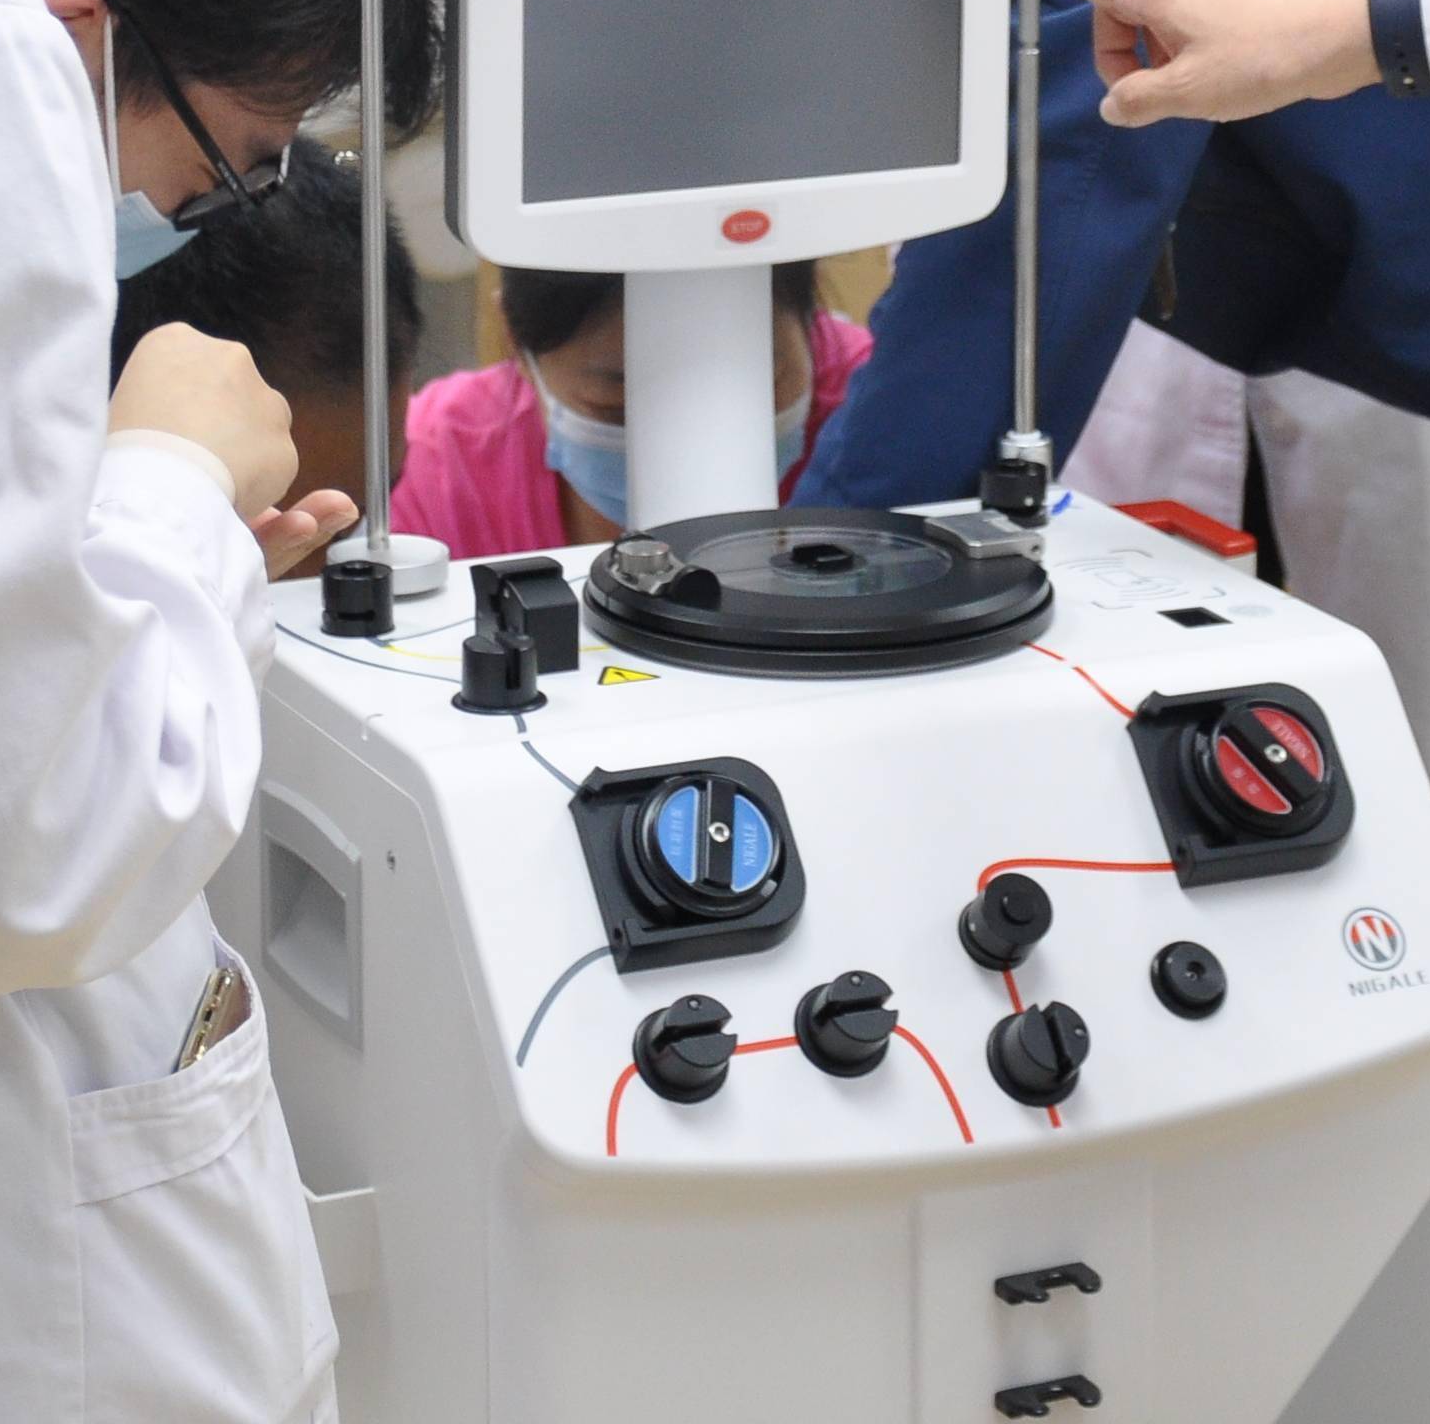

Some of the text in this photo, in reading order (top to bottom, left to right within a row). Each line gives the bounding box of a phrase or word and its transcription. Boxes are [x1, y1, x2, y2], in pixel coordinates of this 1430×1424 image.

[1272, 723, 1308, 758] NIGALE
[743, 823, 756, 866] NIGALE
[1348, 971, 1429, 997] NIGALE
